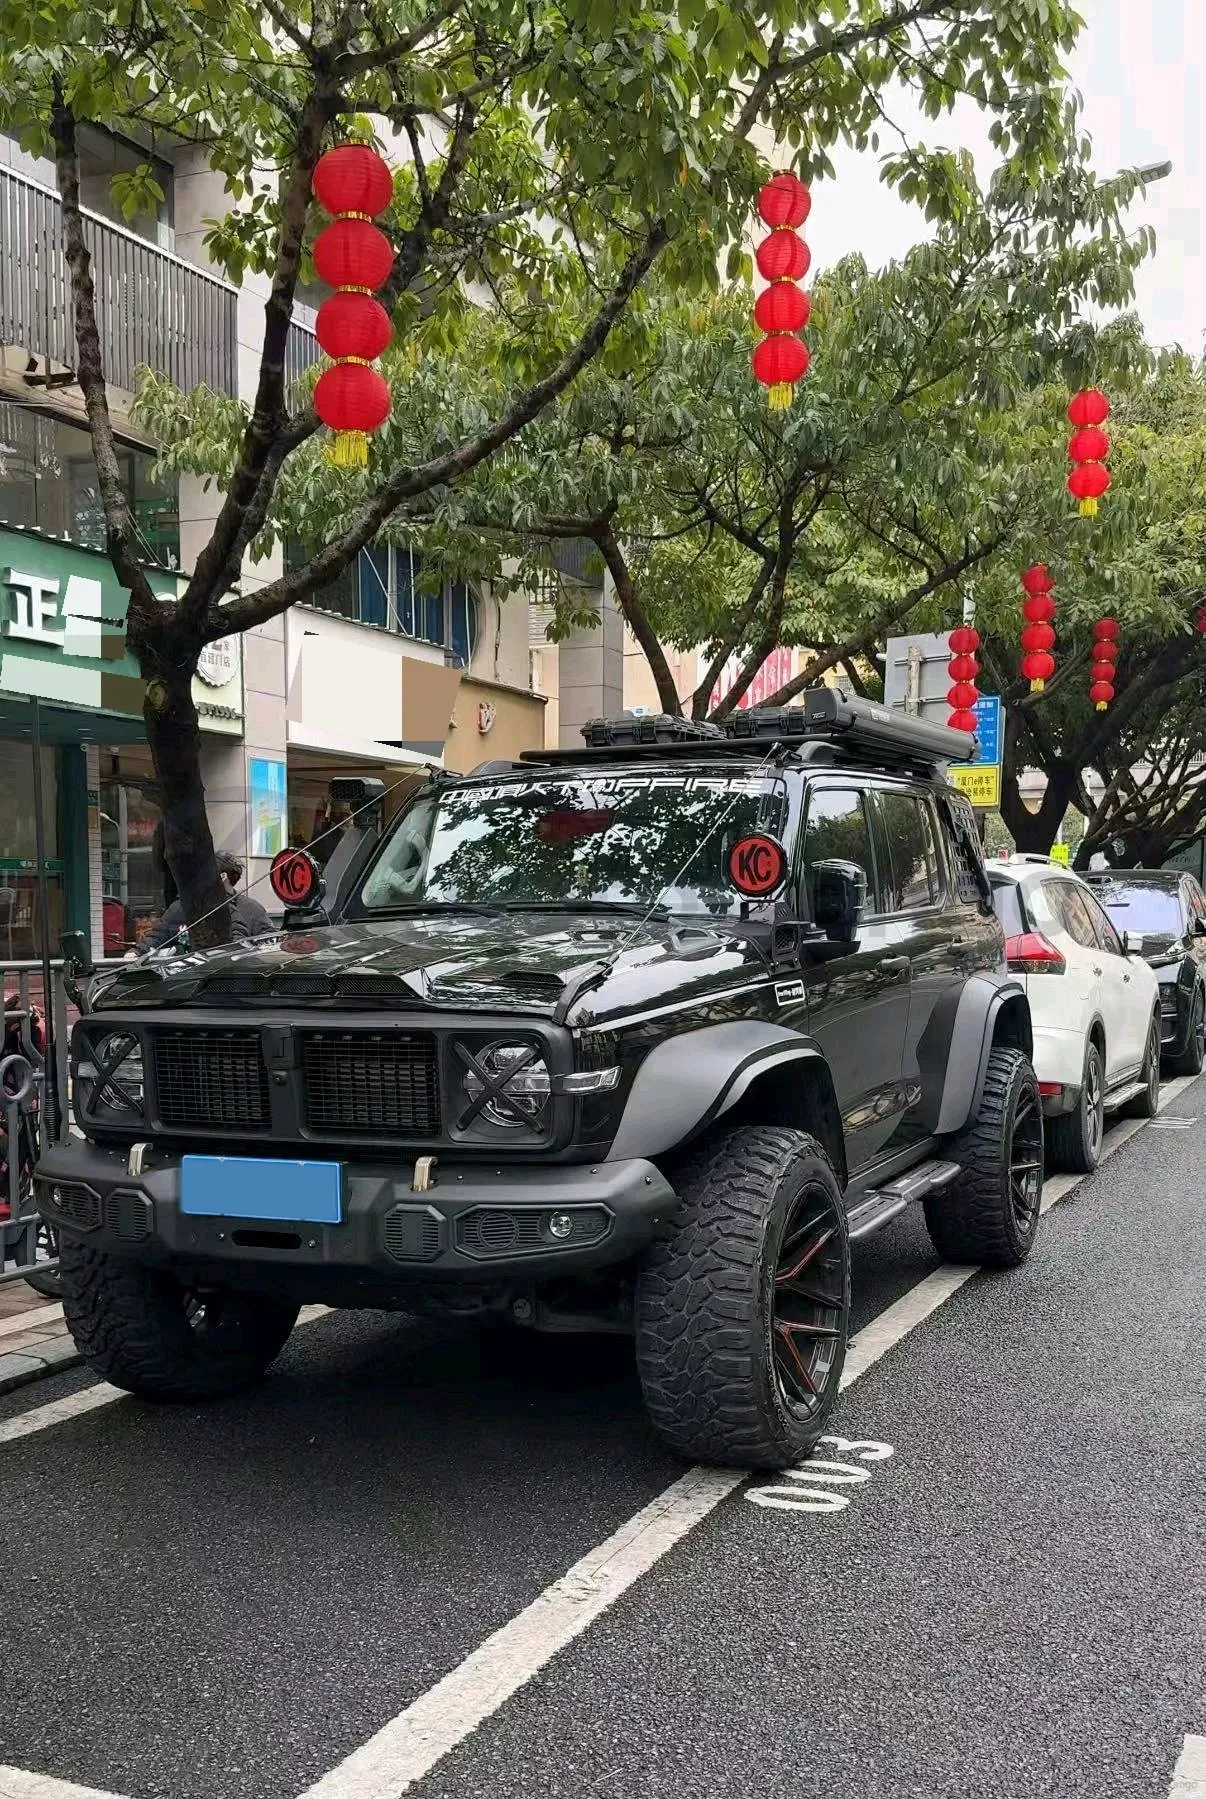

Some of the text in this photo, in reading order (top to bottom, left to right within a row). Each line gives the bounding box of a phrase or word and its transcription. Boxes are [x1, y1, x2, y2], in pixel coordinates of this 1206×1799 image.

[4, 567, 65, 647] 正
[279, 858, 306, 895] KC
[739, 843, 772, 886] KC
